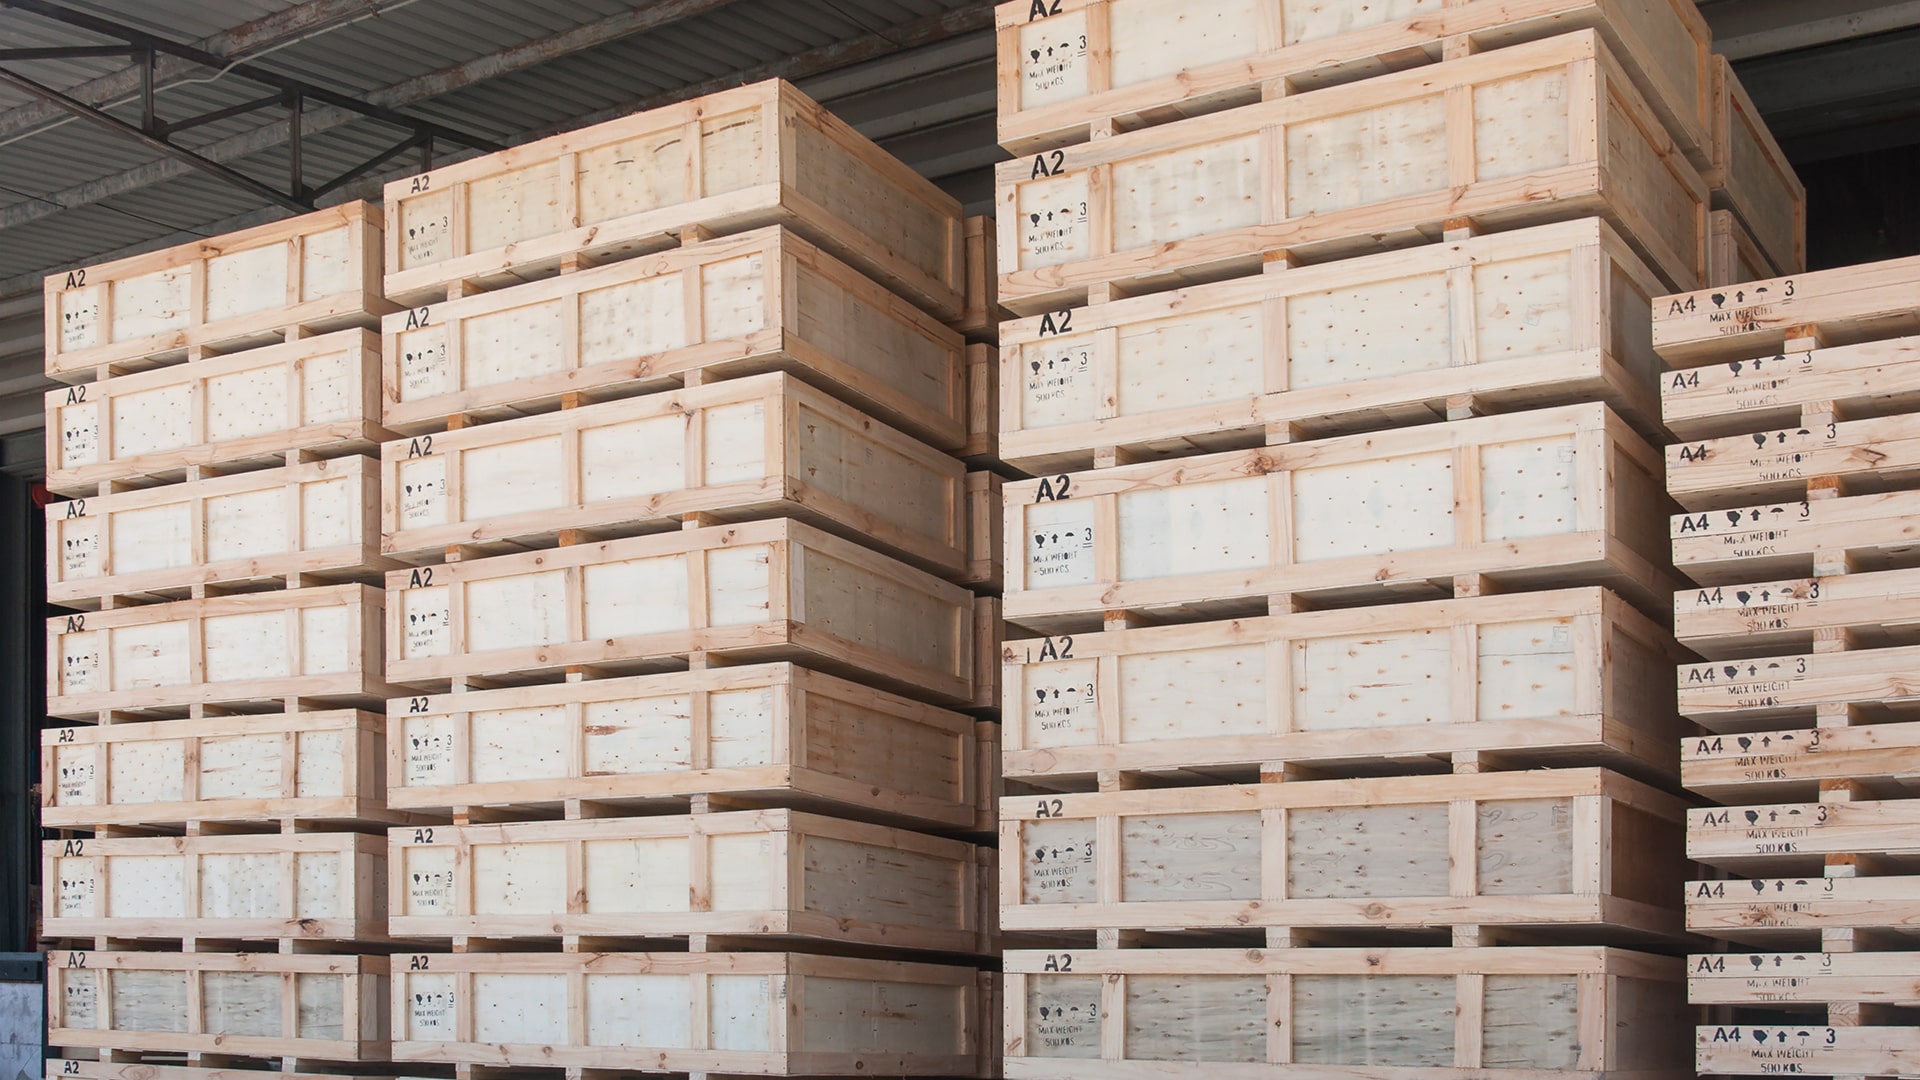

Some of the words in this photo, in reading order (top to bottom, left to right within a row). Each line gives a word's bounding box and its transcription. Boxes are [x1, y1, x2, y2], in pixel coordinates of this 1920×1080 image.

[1029, 0, 1063, 22] A2
[1079, 35, 1087, 49] 3
[1031, 150, 1065, 180] A2
[411, 175, 430, 194] A2
[1080, 202, 1087, 216] 3
[443, 216, 448, 228] 3
[65, 269, 86, 290] A2
[1785, 280, 1794, 296] 3
[1668, 295, 1696, 316] A4
[406, 307, 429, 330] A2
[1039, 309, 1072, 337] A2
[1080, 351, 1088, 365] 3
[1672, 371, 1700, 389] A4
[67, 385, 86, 406] A2
[1826, 423, 1836, 439] 3
[409, 436, 432, 459] A2
[1680, 444, 1707, 462] A4
[440, 478, 445, 490] 3
[1035, 474, 1070, 503] A2
[67, 499, 86, 519] A2
[1800, 501, 1810, 518] 3
[1680, 513, 1709, 533] A4
[1085, 527, 1092, 541] 3
[410, 568, 433, 589] A2
[1696, 587, 1723, 606] A4
[1809, 582, 1820, 599] 3
[444, 609, 449, 620] 3
[1760, 603, 1800, 616] WEIGHT
[66, 615, 85, 633] A2
[1039, 635, 1073, 662] A2
[1796, 657, 1806, 673] 3
[1688, 667, 1715, 683] A4
[1086, 683, 1094, 697] 3
[1728, 685, 1749, 695] MAX
[1753, 681, 1790, 693] WEIGHT
[410, 697, 429, 713] A2
[59, 729, 74, 742] A2
[447, 735, 452, 745] 3
[1810, 730, 1819, 746] 3
[1696, 737, 1723, 755] A4
[1035, 799, 1063, 818] A2
[1817, 805, 1827, 822] 3
[1703, 810, 1730, 827] A4
[414, 828, 433, 843] A2
[64, 840, 83, 857] A2
[1085, 843, 1092, 856] 3
[448, 871, 453, 882] 3
[1824, 877, 1834, 892] 3
[1697, 882, 1725, 898] A4
[68, 952, 86, 968] A2
[411, 955, 429, 970] A2
[1044, 953, 1072, 972] A2
[1697, 956, 1725, 973] A4
[1822, 952, 1832, 967] 3
[449, 992, 455, 1003] 3
[1089, 1003, 1097, 1017] 3
[1713, 1027, 1742, 1043] A4
[1825, 1028, 1836, 1044] 3
[1751, 1050, 1773, 1059] MAX
[64, 1061, 79, 1074] A2
